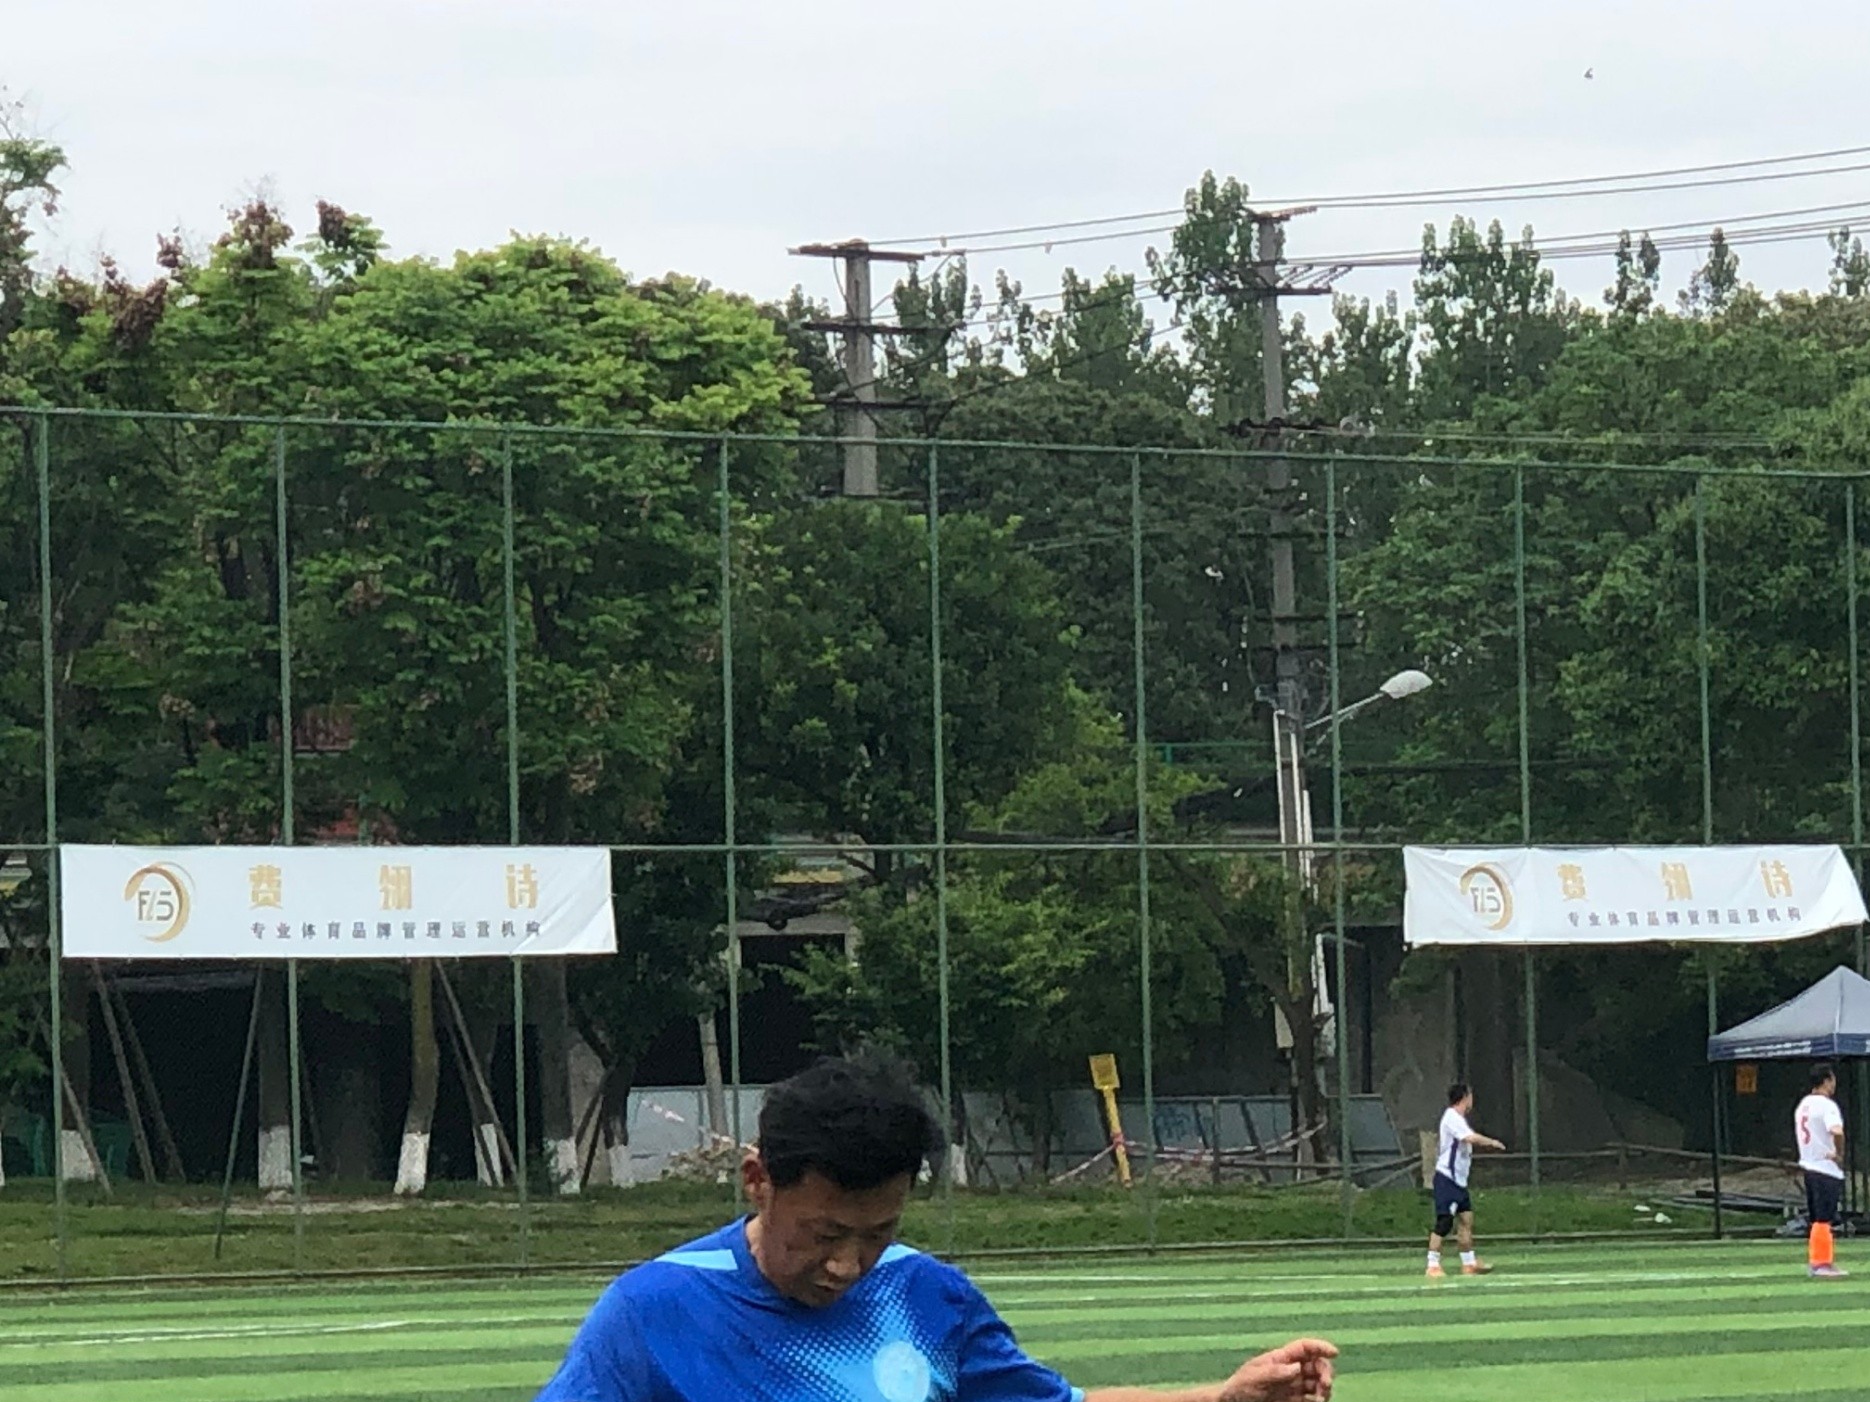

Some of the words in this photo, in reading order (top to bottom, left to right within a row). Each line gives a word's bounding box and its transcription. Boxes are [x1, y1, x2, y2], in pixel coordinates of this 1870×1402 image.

[1568, 905, 1802, 928] 专业体育品牌管理运营机构
[251, 920, 541, 940] 专业体育品牌管理运营机构
